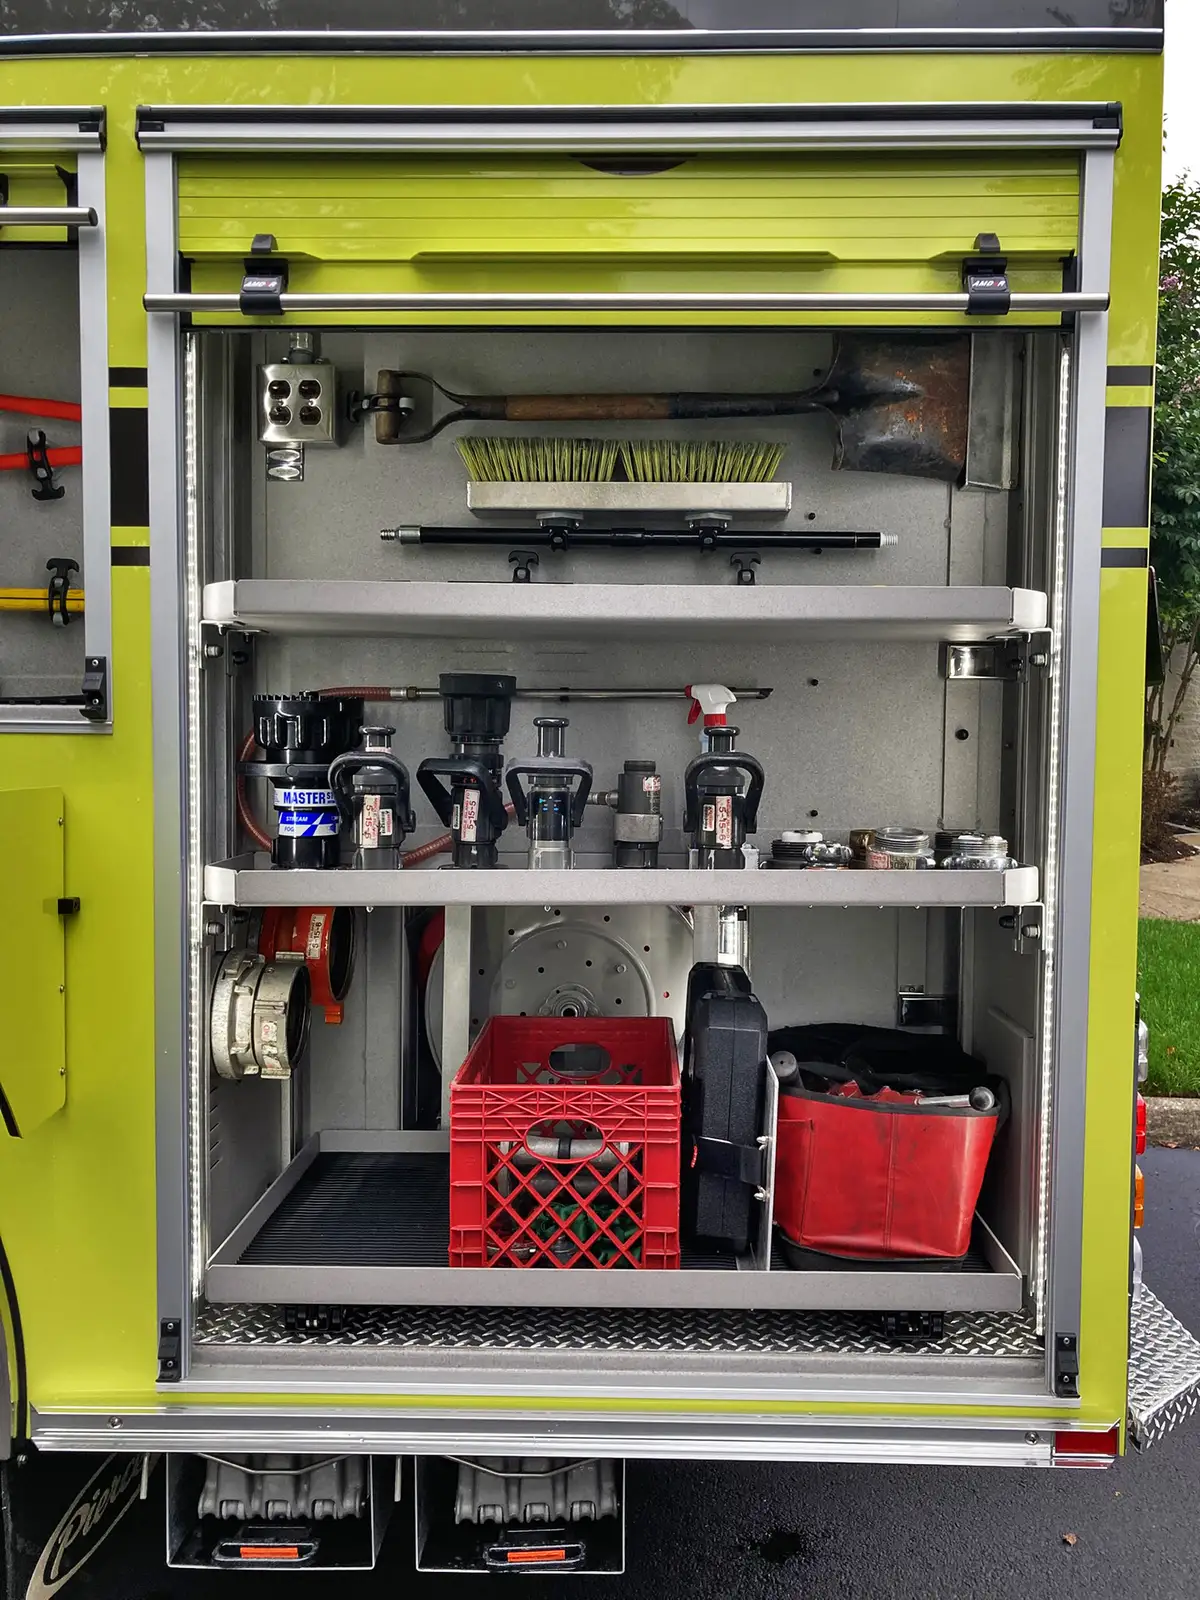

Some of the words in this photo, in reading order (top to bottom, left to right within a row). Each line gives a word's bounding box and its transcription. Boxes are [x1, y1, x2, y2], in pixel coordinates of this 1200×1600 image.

[283, 791, 326, 804] MASTER
[467, 800, 476, 830] 5-15-5
[719, 806, 727, 841] 5-15-6
